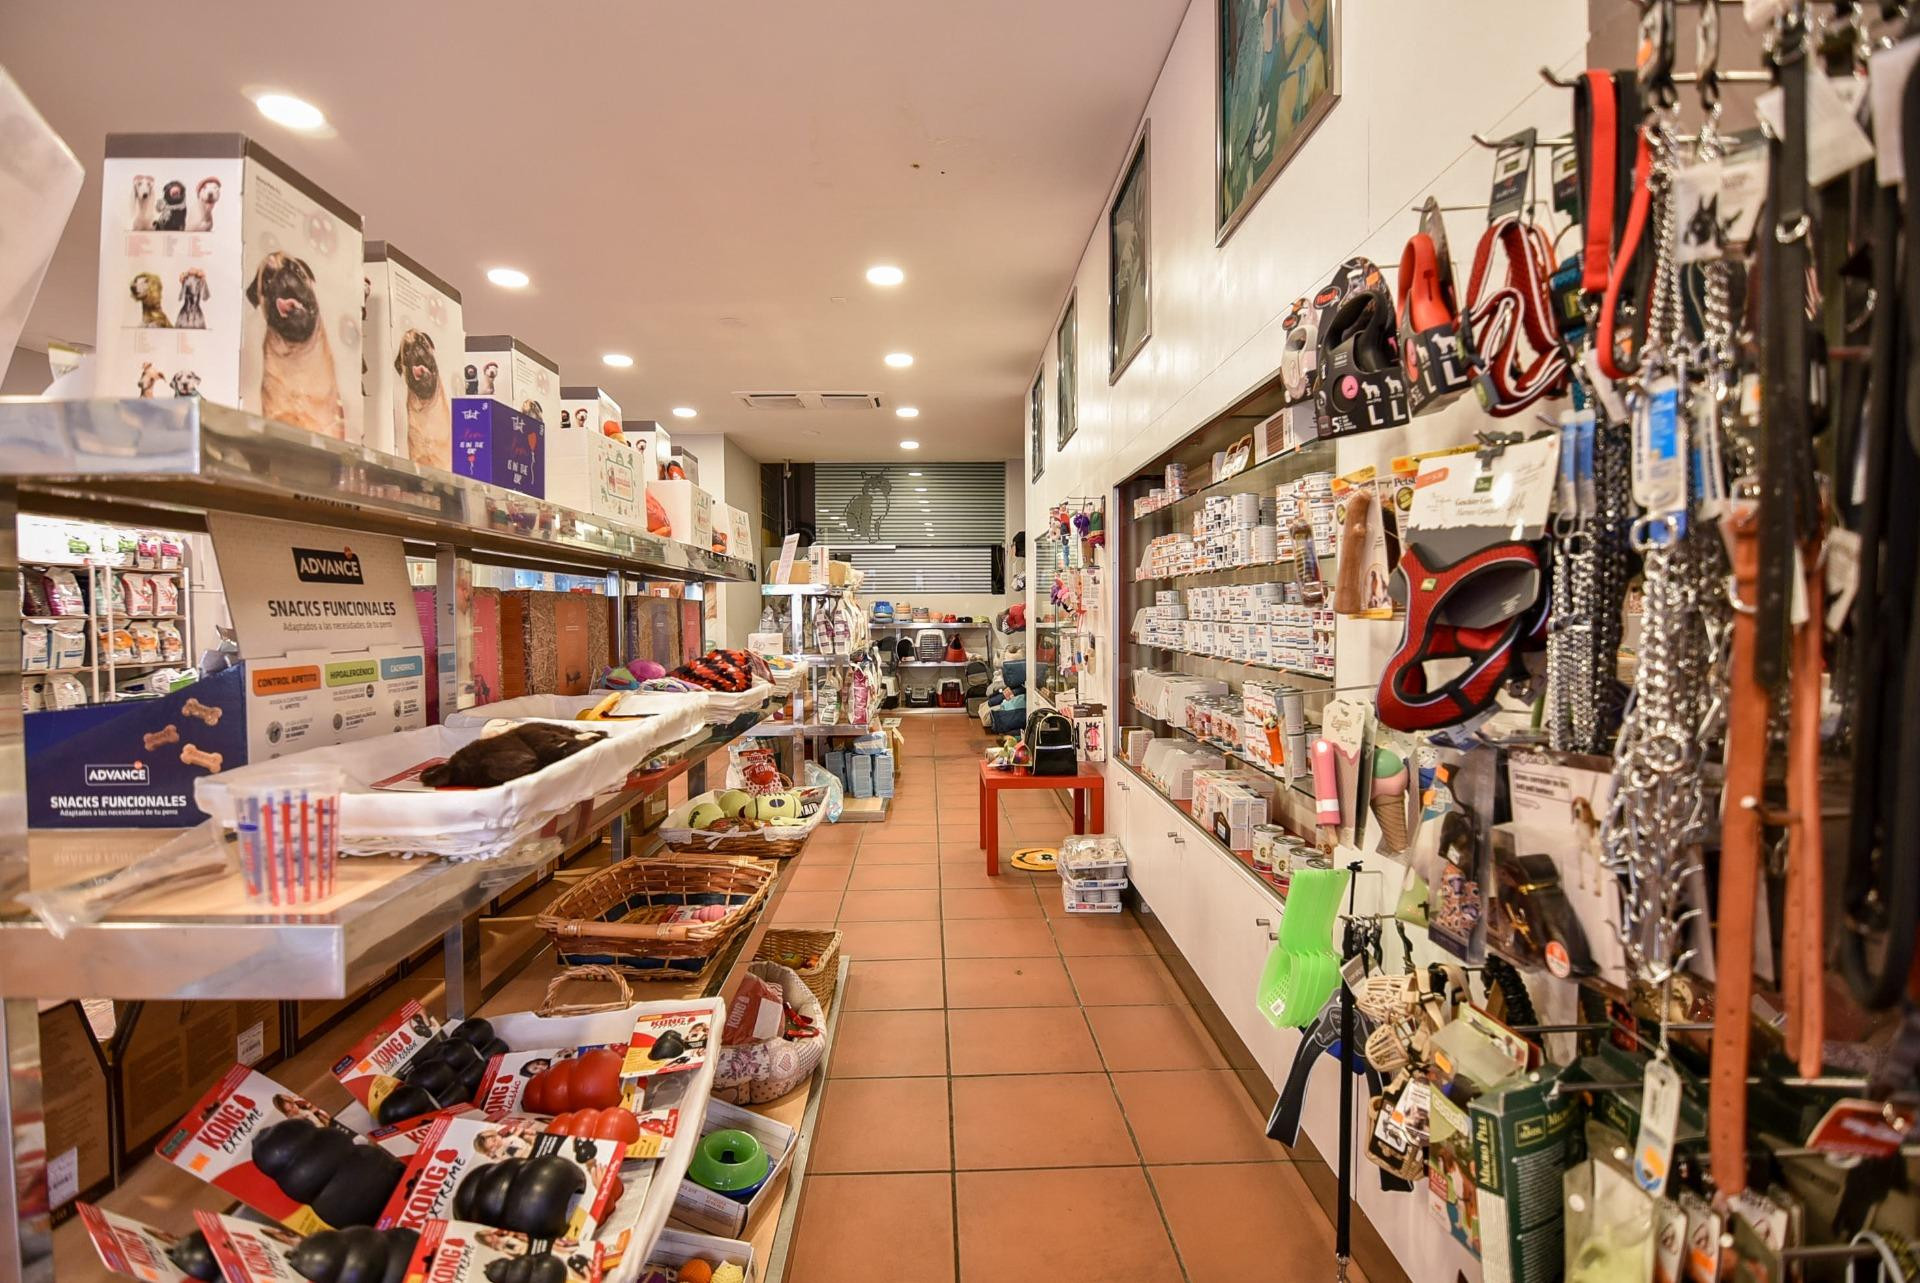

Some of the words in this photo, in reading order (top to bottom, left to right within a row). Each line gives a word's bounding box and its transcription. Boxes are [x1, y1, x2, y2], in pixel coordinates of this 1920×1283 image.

[1424, 370, 1437, 395] L
[1442, 360, 1468, 386] L
[1368, 404, 1384, 426] L
[1391, 400, 1406, 421] L
[1332, 416, 1340, 433] 5
[300, 558, 360, 577] ADVANCE
[268, 600, 321, 617] SNACKS
[324, 601, 396, 616] FUNCIONALES
[283, 622, 317, 633] Adaptados
[333, 621, 365, 630] necesidades
[257, 676, 291, 688] CONTROL
[291, 673, 317, 684] APETITO
[89, 769, 146, 781] ADVANCE
[51, 796, 99, 808] SNACKS
[102, 795, 187, 807] FUNCIONALES
[60, 809, 92, 818] Adaptados
[98, 809, 107, 817] las
[108, 809, 144, 817] necesidades
[650, 1017, 686, 1027] KONG
[726, 1002, 747, 1029] KONG
[371, 1037, 404, 1068] KONG
[484, 1086, 510, 1114] ONG
[197, 1104, 247, 1151] KONG
[222, 1108, 264, 1154] EXTREME
[400, 1166, 448, 1229] KONG
[427, 1157, 466, 1219] XTREME
